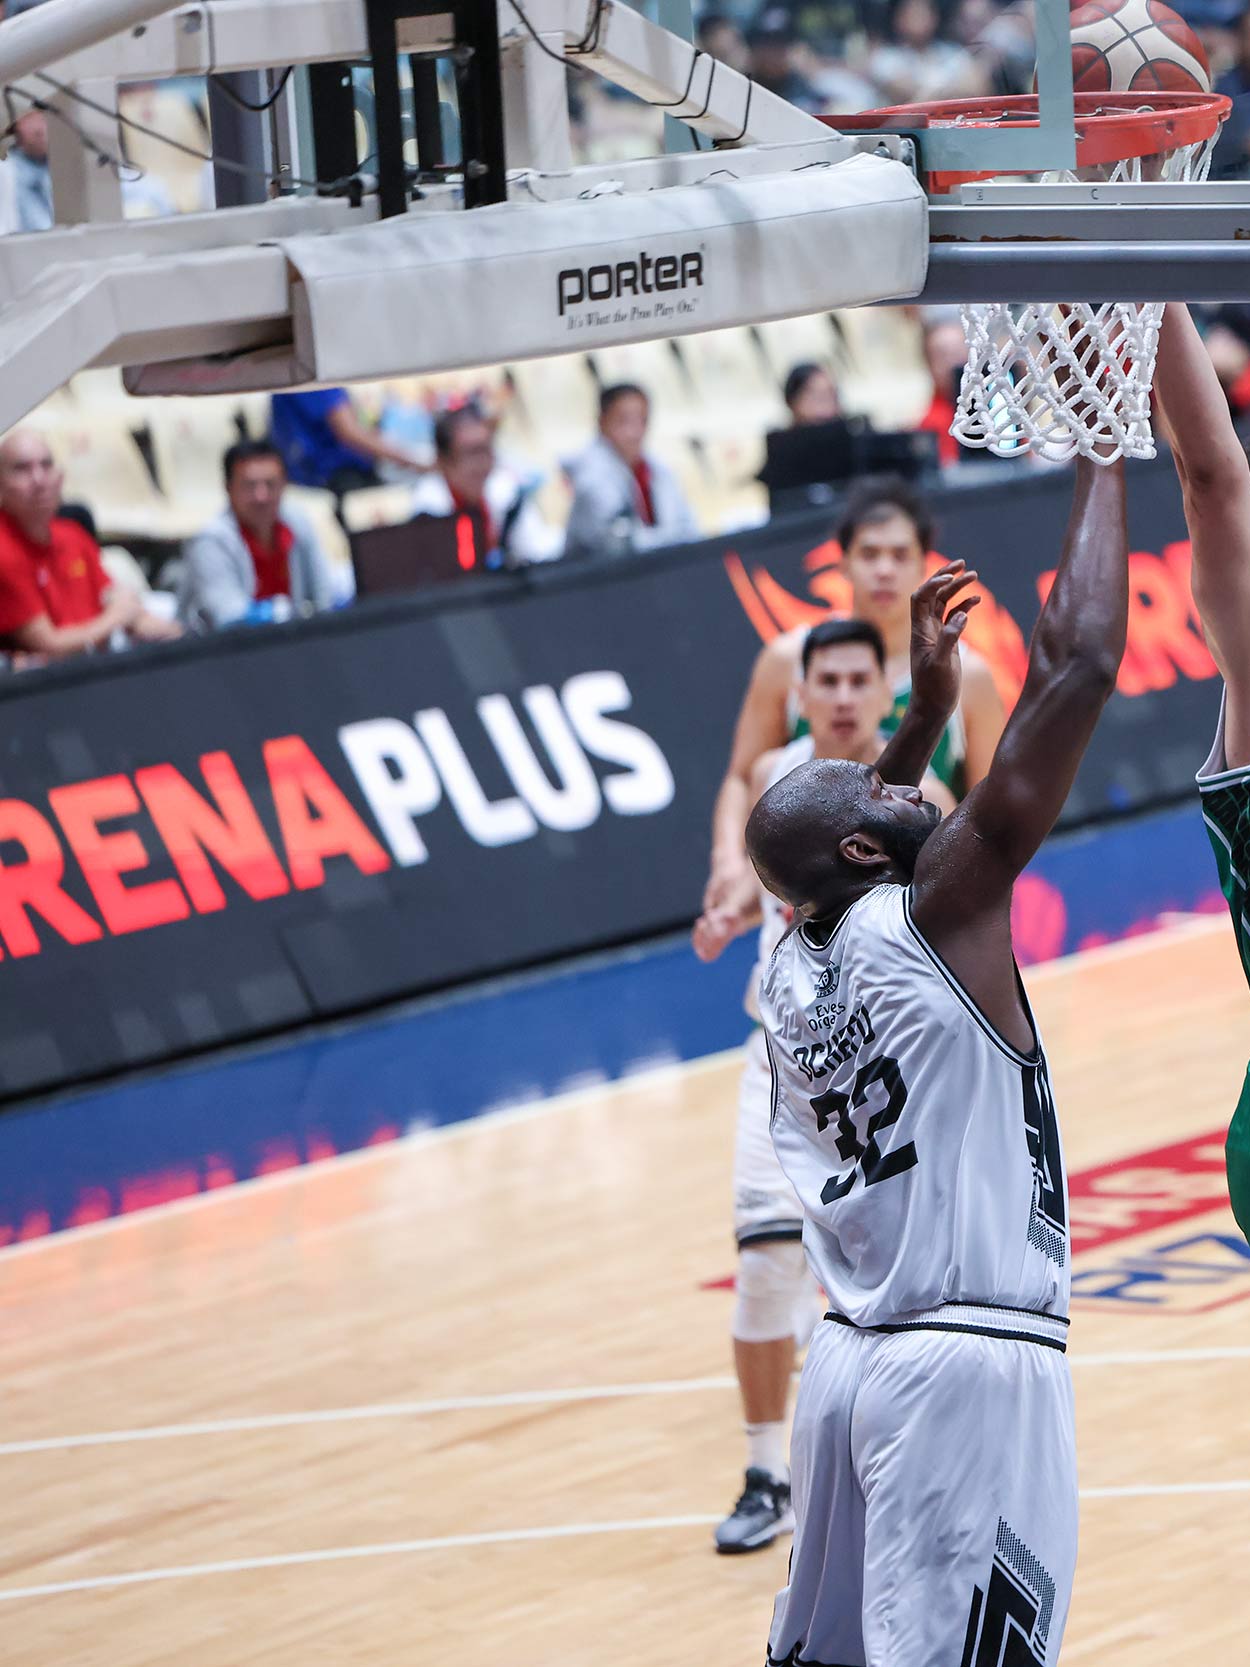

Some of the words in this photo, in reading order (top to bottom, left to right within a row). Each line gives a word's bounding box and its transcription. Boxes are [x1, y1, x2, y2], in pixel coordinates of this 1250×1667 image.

[0, 670, 675, 961] RENAPLUS
[808, 1014, 836, 1032] Orga
[815, 1001, 846, 1019] Eves
[810, 1054, 919, 1206] 32
